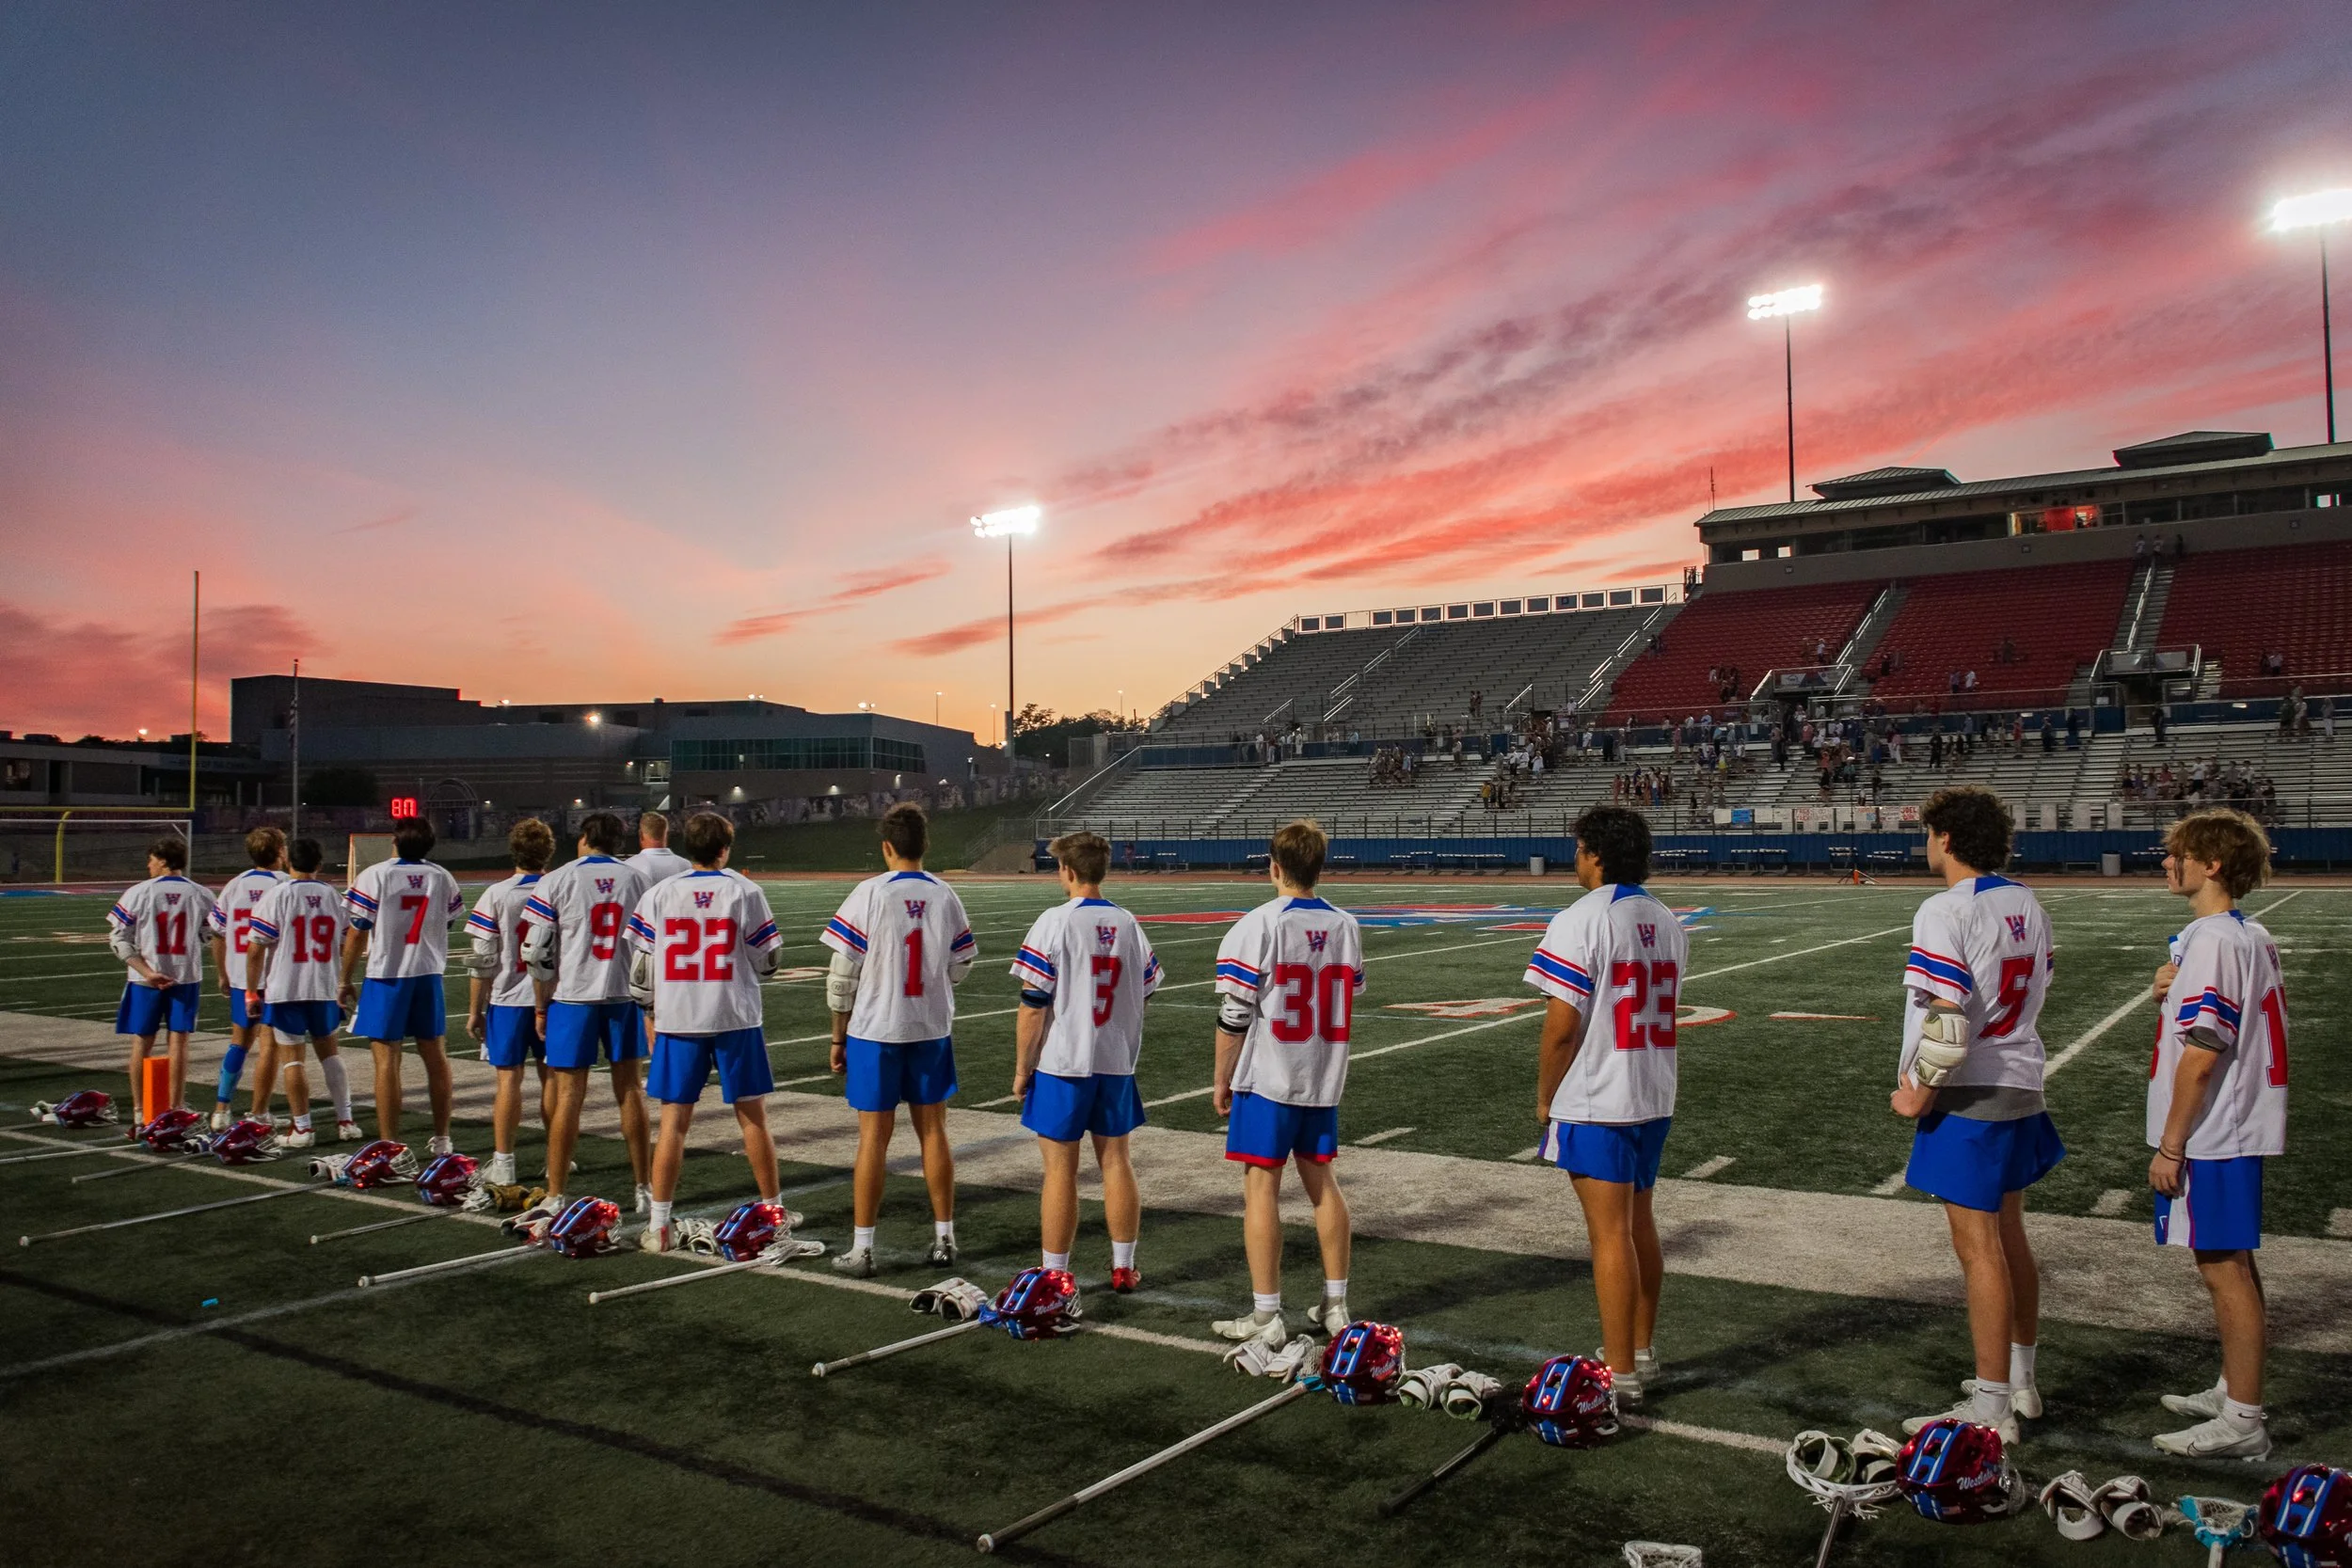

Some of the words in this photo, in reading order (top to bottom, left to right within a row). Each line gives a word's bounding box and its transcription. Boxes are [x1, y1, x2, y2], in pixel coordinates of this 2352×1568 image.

[167, 894, 183, 907] W
[306, 895, 323, 909] W
[408, 874, 425, 891] W
[595, 878, 616, 895] W
[693, 891, 716, 911] W
[402, 896, 431, 946] 7
[591, 902, 625, 962] 9
[905, 900, 927, 920] W
[2005, 914, 2028, 942] W
[157, 912, 186, 957] 11
[293, 915, 337, 964] 19
[664, 918, 739, 984] 22
[1096, 927, 1119, 947] W
[1305, 930, 1330, 954] W
[1637, 924, 1657, 949] W
[905, 929, 924, 998] 1
[1091, 956, 1122, 1028] 3
[1270, 962, 1355, 1044] 30
[1612, 961, 1677, 1052] 23
[1983, 958, 2036, 1038] 5
[2260, 984, 2289, 1088] 1
